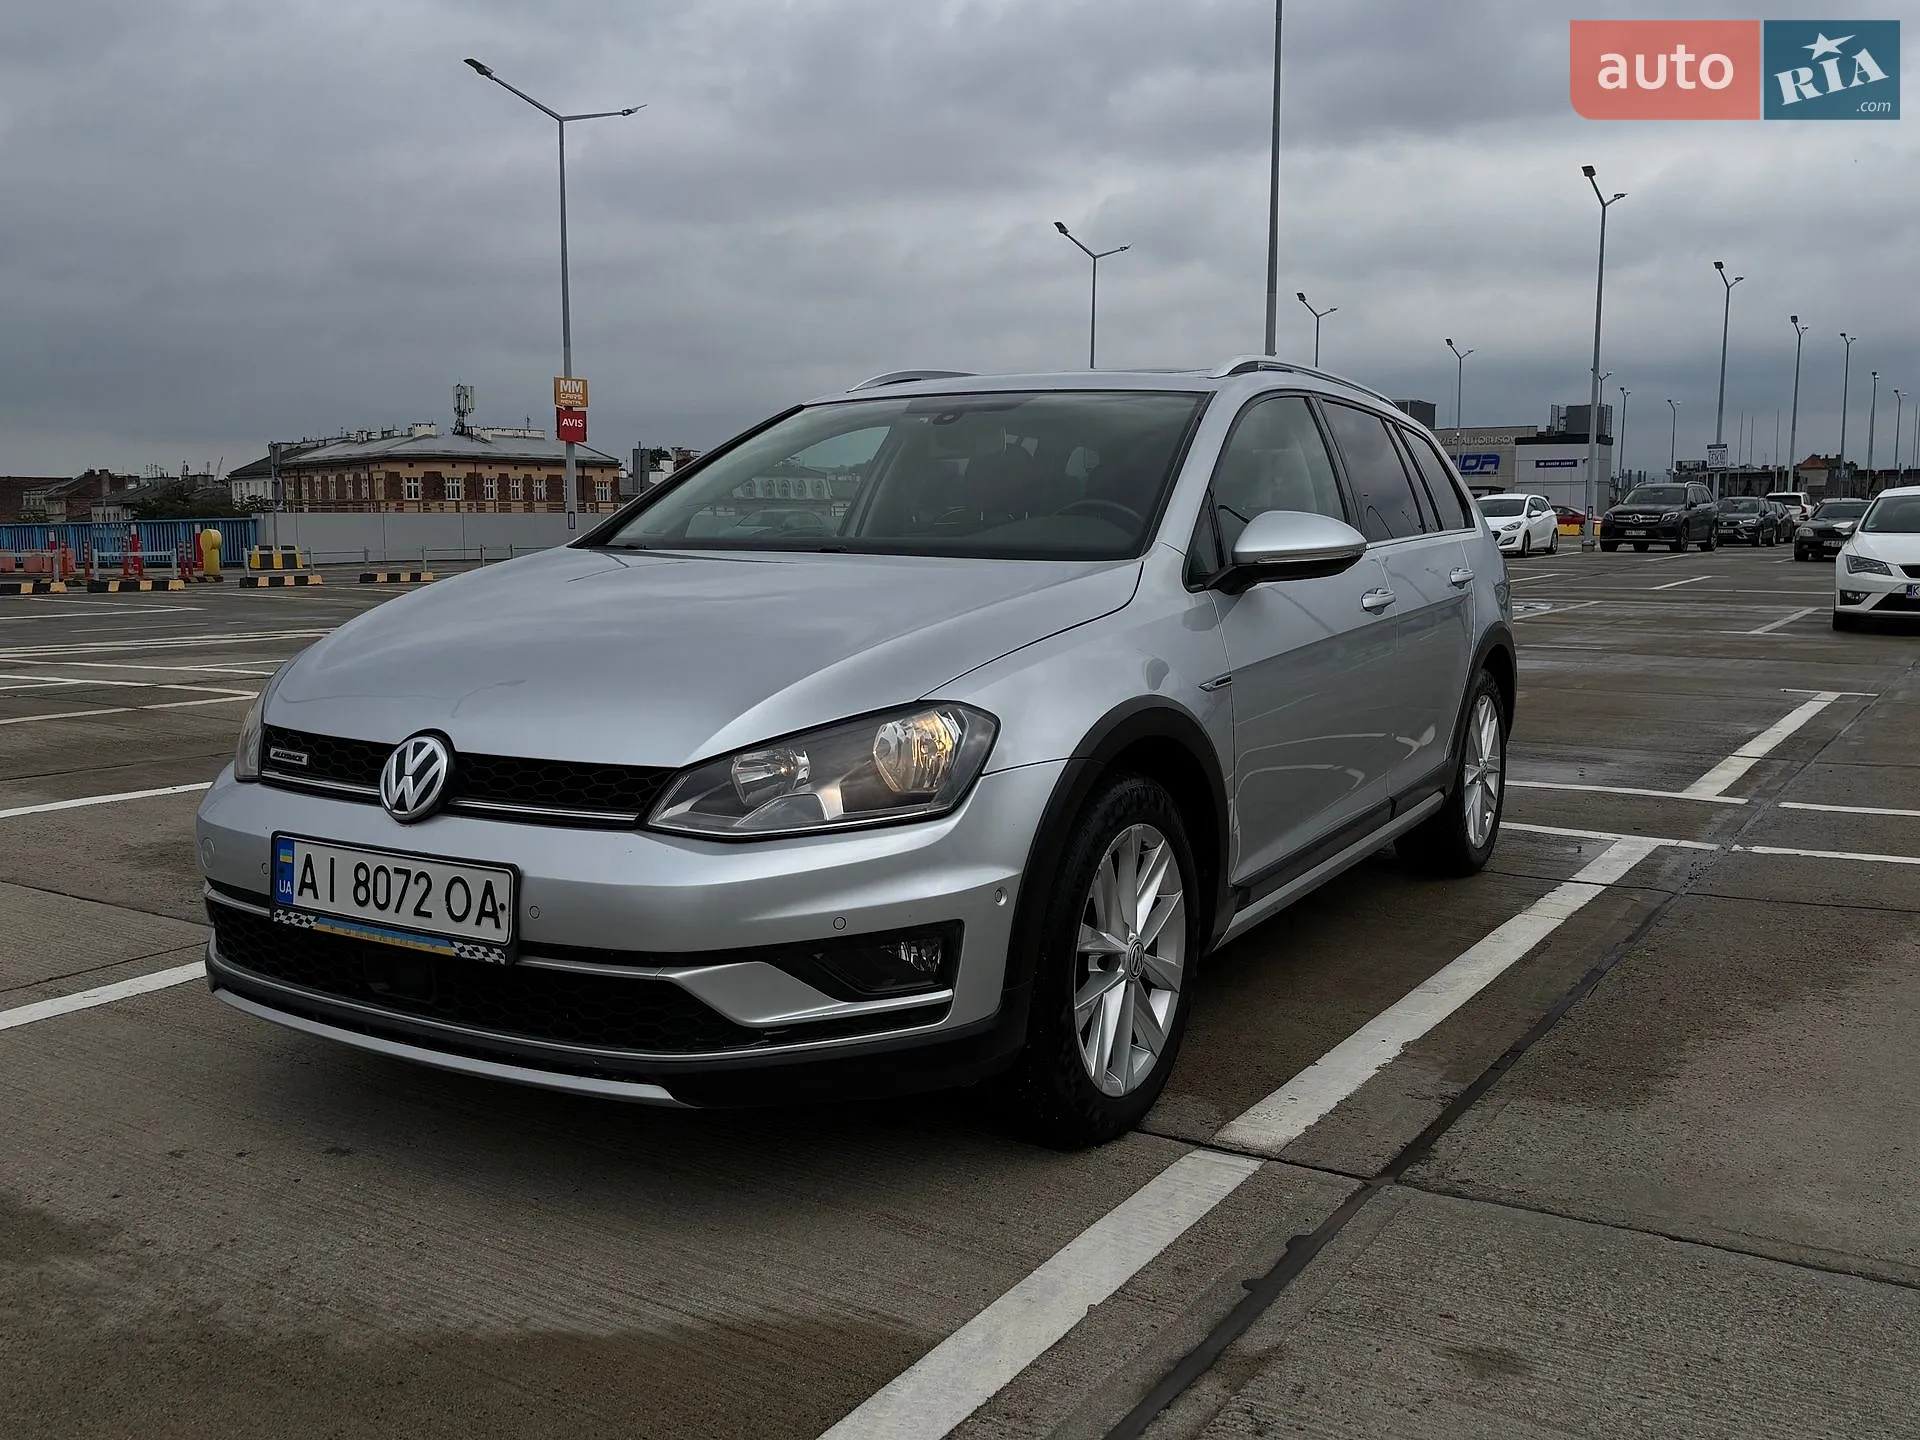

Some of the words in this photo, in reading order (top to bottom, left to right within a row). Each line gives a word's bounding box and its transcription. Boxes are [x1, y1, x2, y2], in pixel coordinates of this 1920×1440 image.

[560, 380, 583, 394] MM
[562, 418, 583, 428] AVIS
[279, 879, 293, 895] UA
[298, 853, 335, 903] AI
[353, 861, 433, 919] 8072
[444, 875, 502, 930] OA
